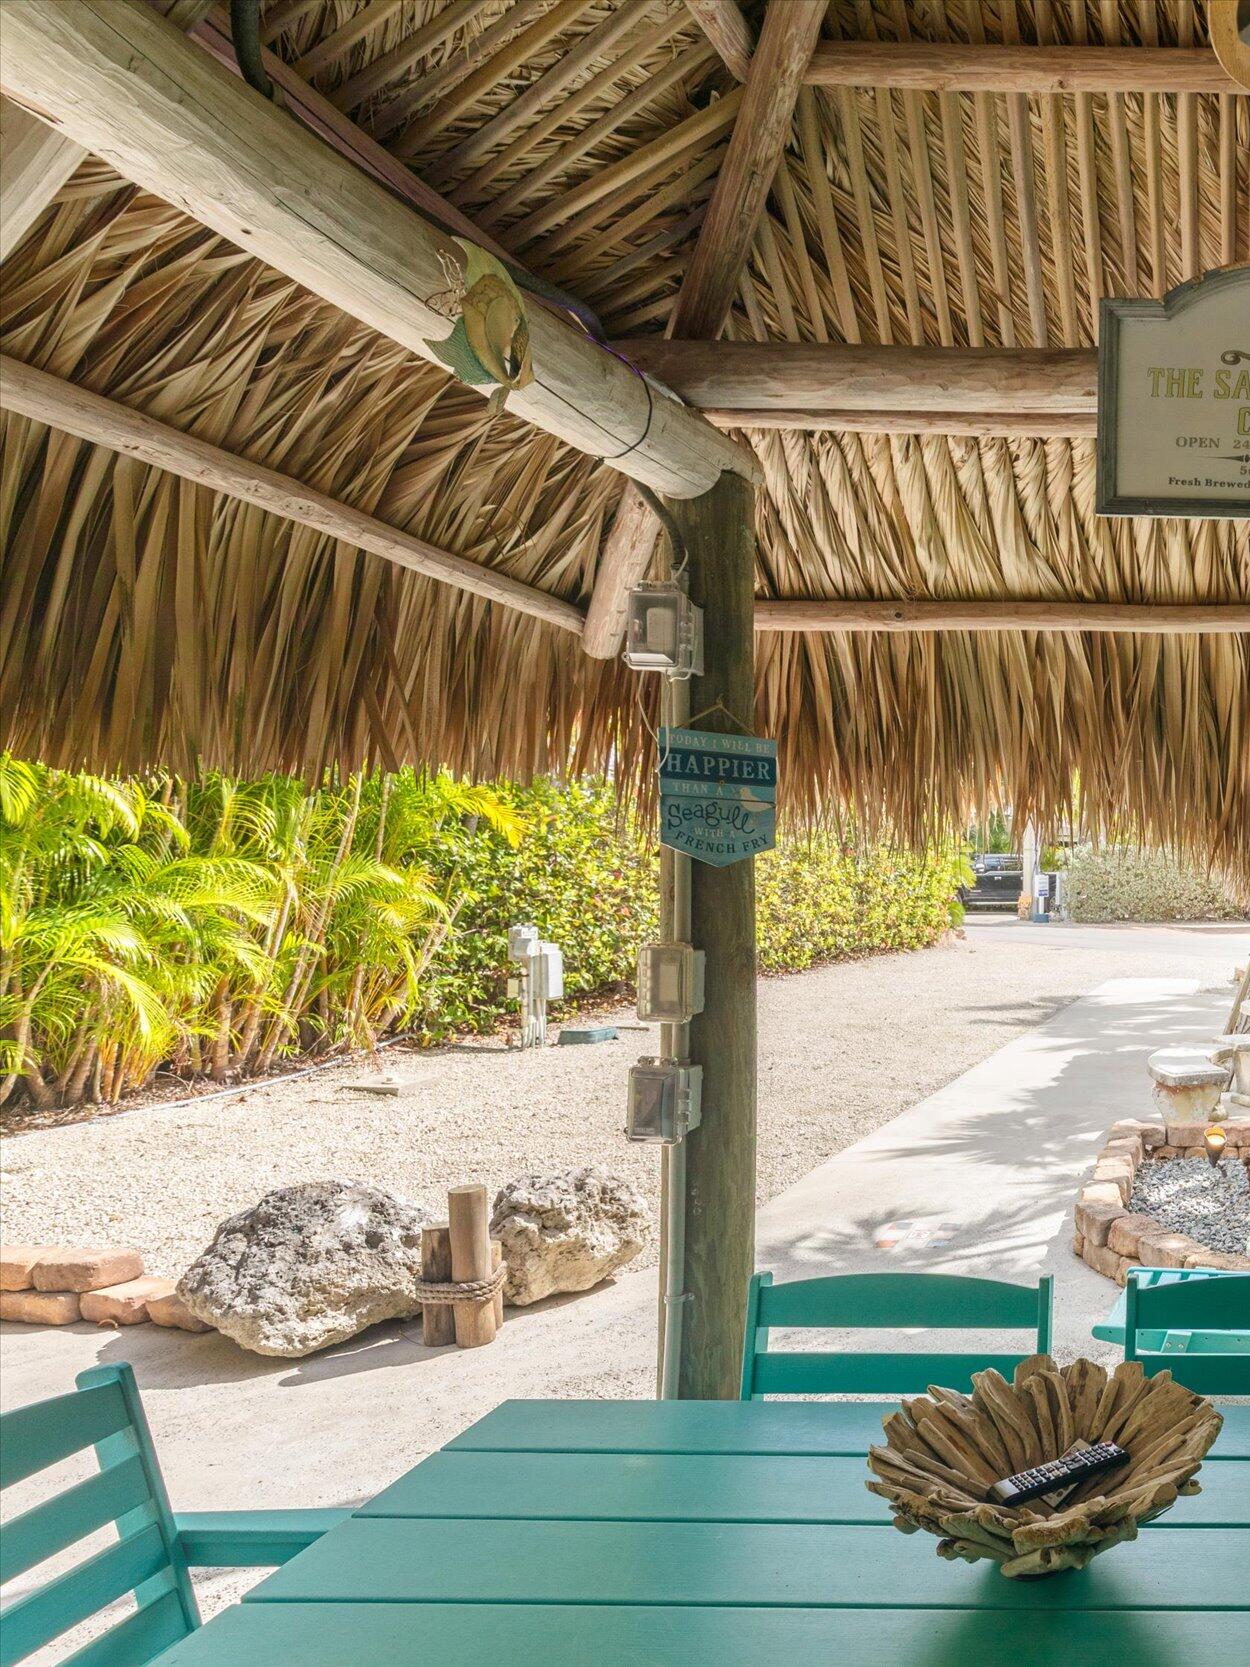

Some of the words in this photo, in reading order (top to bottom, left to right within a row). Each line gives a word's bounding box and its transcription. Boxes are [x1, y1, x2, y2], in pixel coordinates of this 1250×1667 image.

[1147, 367, 1204, 398] THE
[1175, 436, 1220, 449] OPEN
[1233, 439, 1250, 450] 24
[1168, 476, 1201, 487] Fresh
[669, 733, 707, 747] TODAY
[711, 739, 718, 750] I
[722, 738, 752, 753] WILL
[756, 743, 770, 755] BE
[666, 753, 771, 780] HAPPIER
[672, 781, 708, 795] THAN
[715, 785, 724, 797] A
[667, 801, 755, 834] Seagull
[675, 829, 736, 854] FRENCH
[742, 833, 769, 851] FRY
[694, 826, 724, 838] WITH
[728, 829, 736, 839] A
